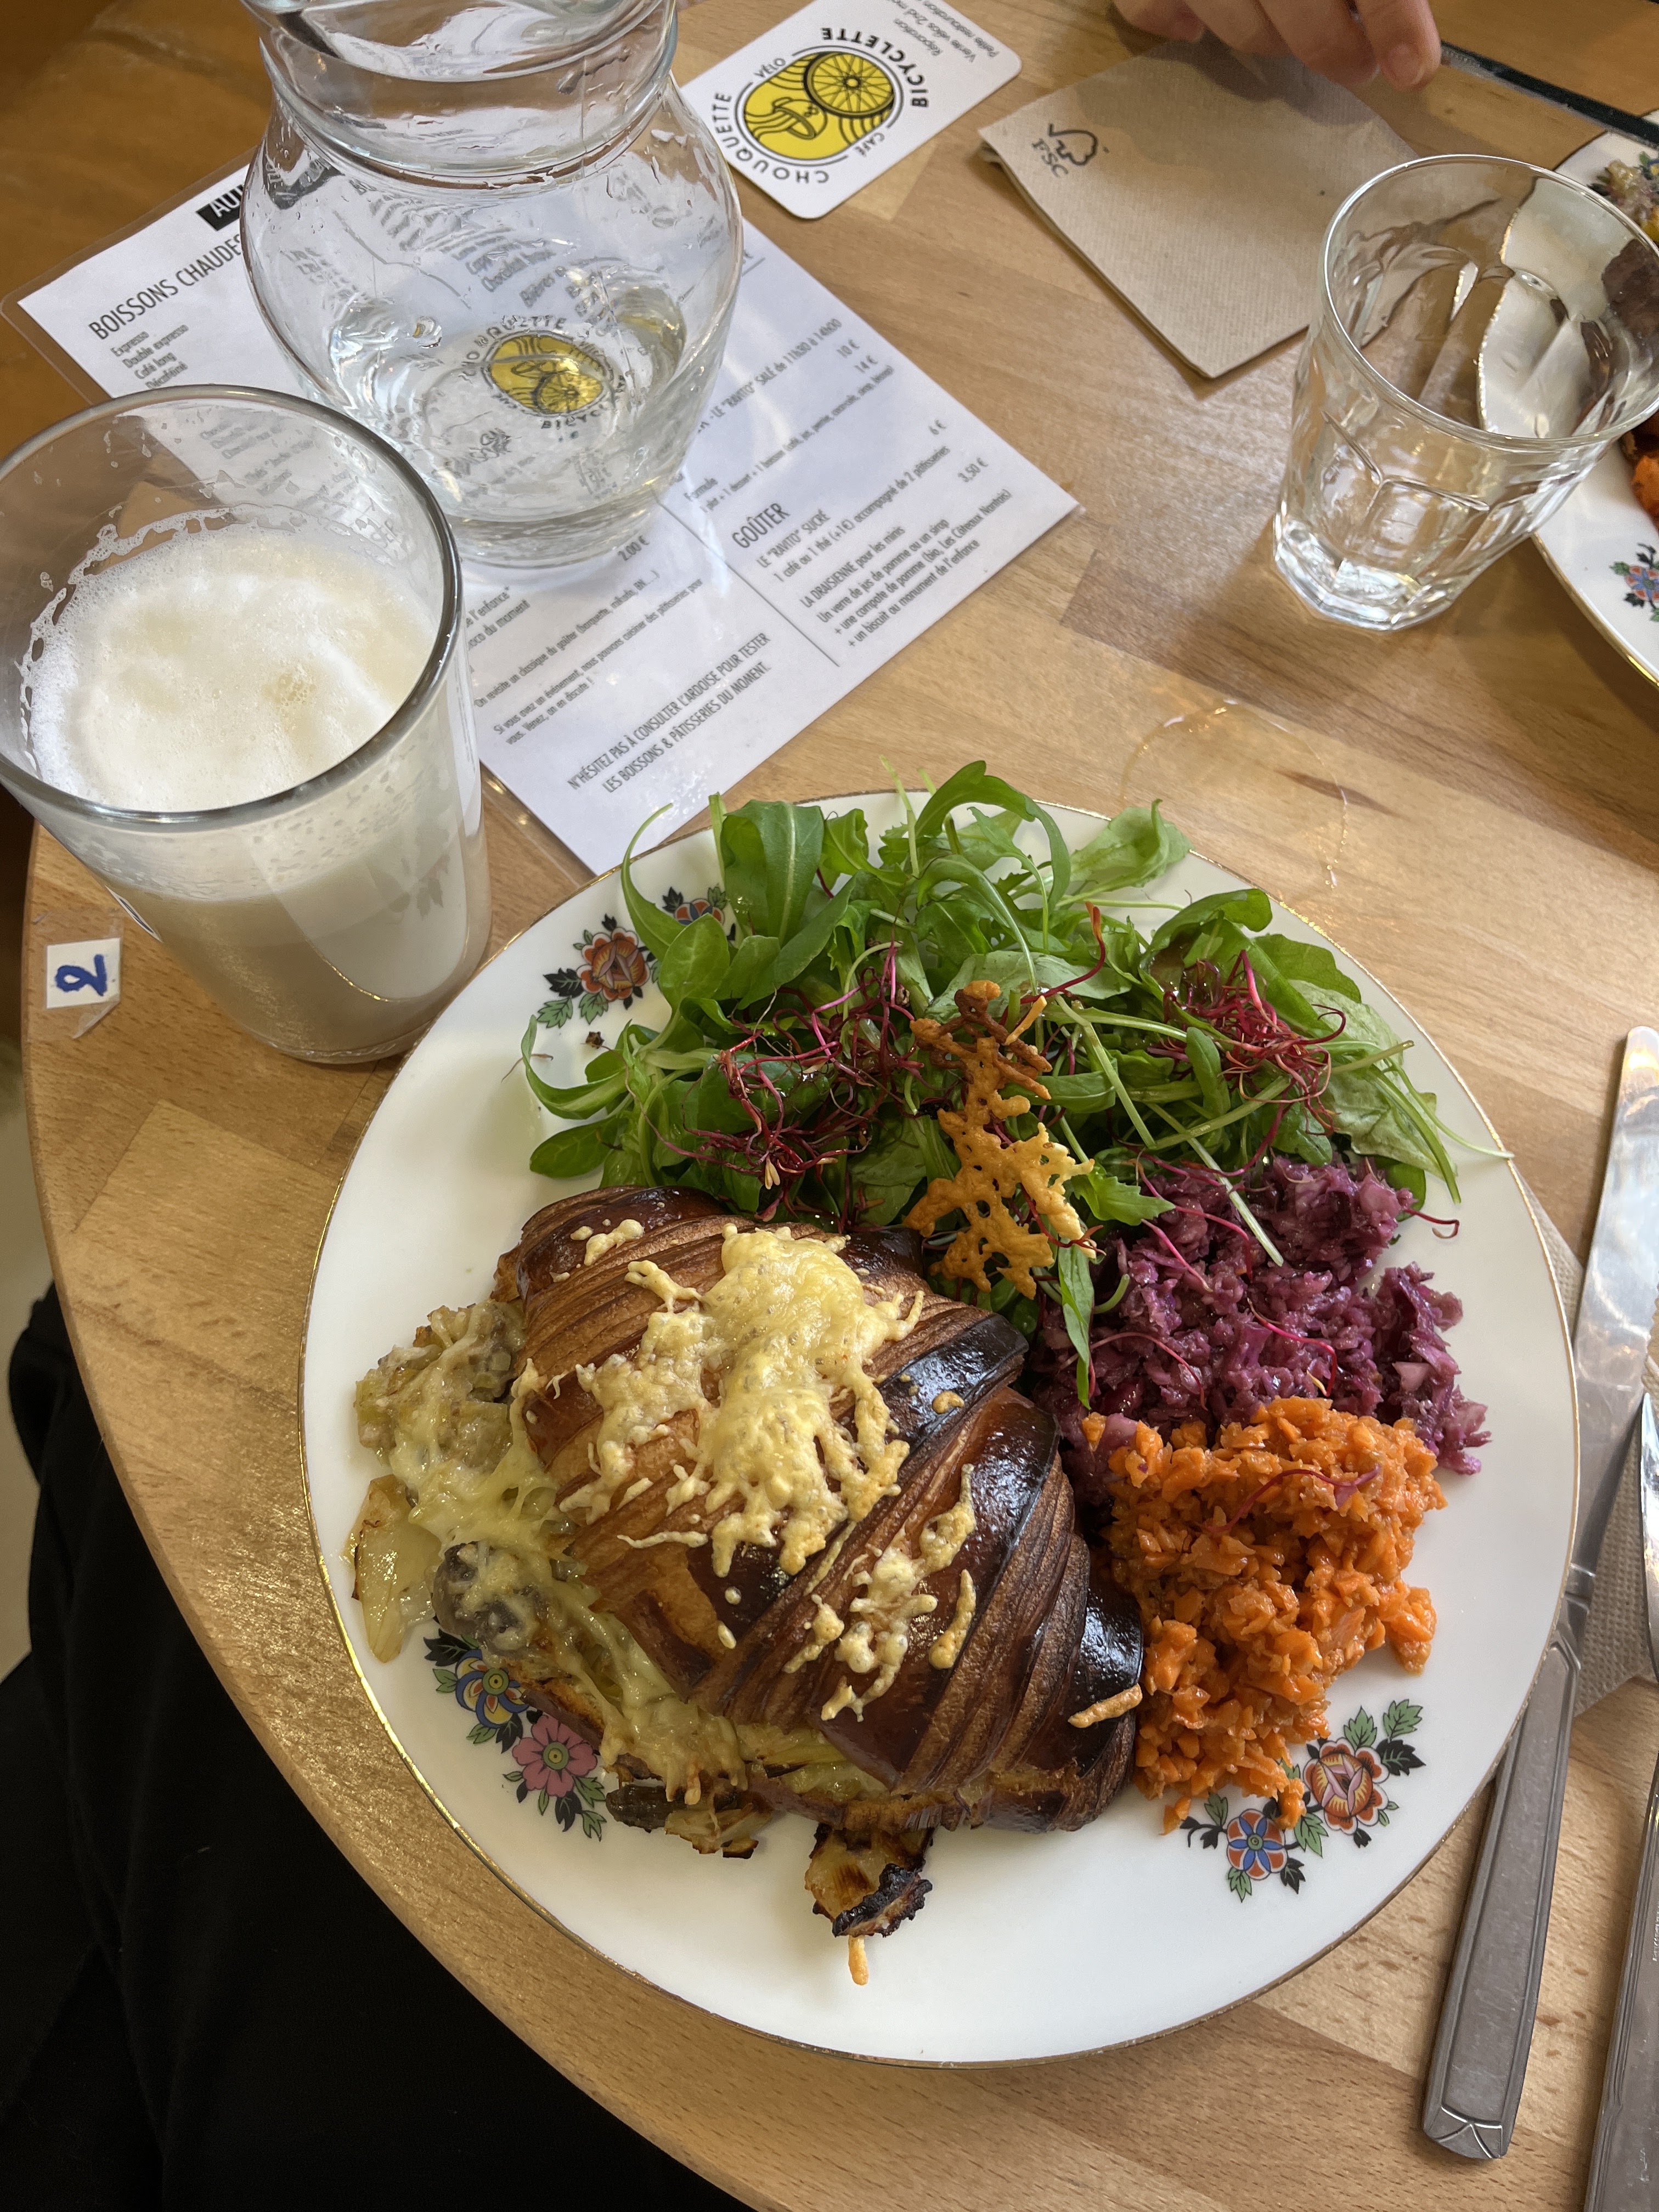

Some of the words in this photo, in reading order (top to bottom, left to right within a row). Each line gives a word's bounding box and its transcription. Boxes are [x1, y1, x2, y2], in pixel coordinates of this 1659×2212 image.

[754, 57, 787, 81] VÉLO
[820, 27, 930, 109] BICYCLETTE
[712, 92, 830, 184] CHOUQUETTE
[853, 132, 885, 157] CAFÉ
[1031, 137, 1069, 178] FSC
[88, 279, 178, 340] BOISSONS
[134, 363, 157, 380] Café
[836, 345, 853, 358] 10
[848, 339, 860, 349] €
[866, 355, 878, 365] €
[928, 426, 940, 436] 6
[935, 420, 946, 430] €
[976, 457, 988, 467] €
[732, 503, 791, 549] GOÛTER
[756, 555, 772, 568] LE
[766, 529, 802, 557] "RAVITO"
[800, 509, 831, 534] SUCRÉ
[773, 573, 785, 582] 1
[783, 560, 802, 577] café
[799, 554, 812, 565] ou
[807, 547, 819, 556] 1
[815, 537, 832, 551] thé
[854, 486, 899, 523] accompagné
[894, 479, 909, 490] de
[903, 471, 916, 482] 2
[913, 445, 951, 478] pâtisseries
[800, 596, 816, 608] LA
[810, 561, 858, 600] DRAISIENNE
[855, 550, 874, 569] pour
[868, 541, 886, 554] les
[816, 611, 834, 623] Un
[831, 596, 852, 613] verre
[848, 588, 863, 599] de
[857, 579, 874, 593] jus
[870, 571, 884, 582] de
[882, 549, 911, 575] pomme
[909, 541, 922, 552] ou
[918, 533, 932, 544] un
[929, 519, 950, 536] sirop
[840, 615, 858, 630] une
[855, 590, 888, 618] compote
[884, 582, 899, 593] de
[895, 561, 926, 587] pomme
[937, 536, 956, 549] Les
[854, 630, 868, 642] un
[861, 611, 890, 633] biscuit
[888, 603, 901, 615] ou
[898, 572, 938, 606] monument
[934, 565, 949, 576] de
[493, 724, 505, 735] Si
[503, 714, 521, 729] vous
[534, 696, 546, 706] un
[580, 657, 599, 672] nous
[596, 638, 624, 662] pouvons
[644, 612, 659, 623] des
[687, 578, 703, 593] pour
[509, 674, 521, 684] un
[545, 646, 558, 656] du
[556, 699, 567, 709] en
[567, 753, 614, 790] N'HÉSITEZ
[608, 741, 630, 759] PAS
[623, 735, 638, 748] À
[633, 701, 682, 741] CONSULTER
[676, 670, 721, 707] L'ARDOISE
[715, 653, 743, 676] POUR
[737, 633, 771, 658] TESTER
[602, 775, 623, 793] LES
[618, 744, 664, 781] BOISSONS
[661, 738, 674, 749] &
[668, 699, 721, 742] PÂTISSERIES
[716, 689, 734, 705] DU
[55, 953, 108, 997] 2
